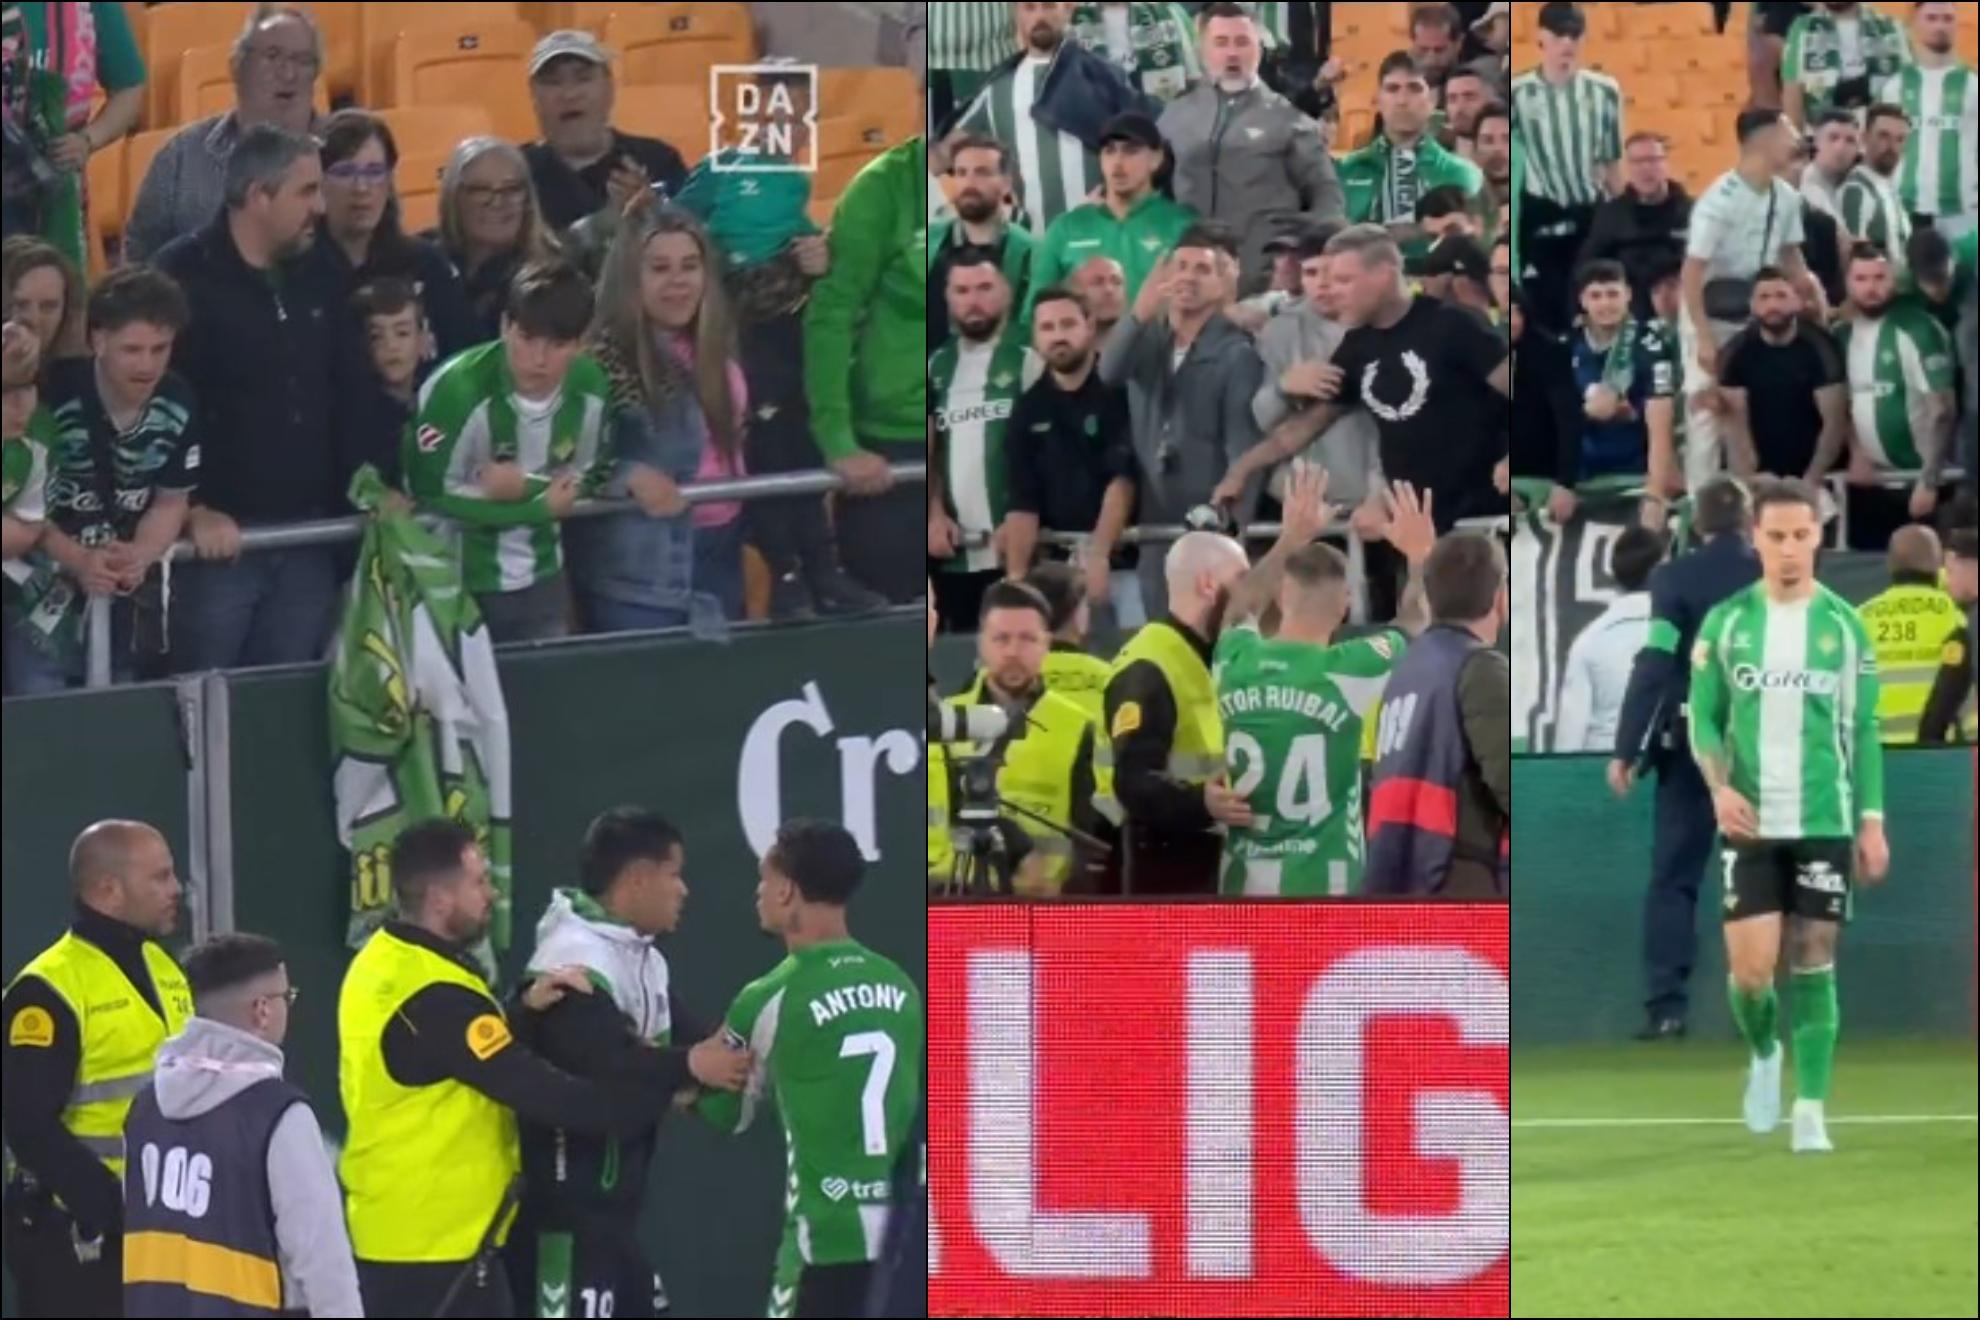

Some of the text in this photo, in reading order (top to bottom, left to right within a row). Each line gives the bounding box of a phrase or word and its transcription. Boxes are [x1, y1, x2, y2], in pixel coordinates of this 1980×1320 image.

[1878, 621, 1916, 641] 238
[1266, 685, 1348, 732] RUIBAL
[738, 680, 926, 861] Cr
[1227, 731, 1332, 827] 24
[809, 983, 906, 1026] ANTONY
[839, 1031, 895, 1155] 7
[927, 945, 1509, 1284] LIG
